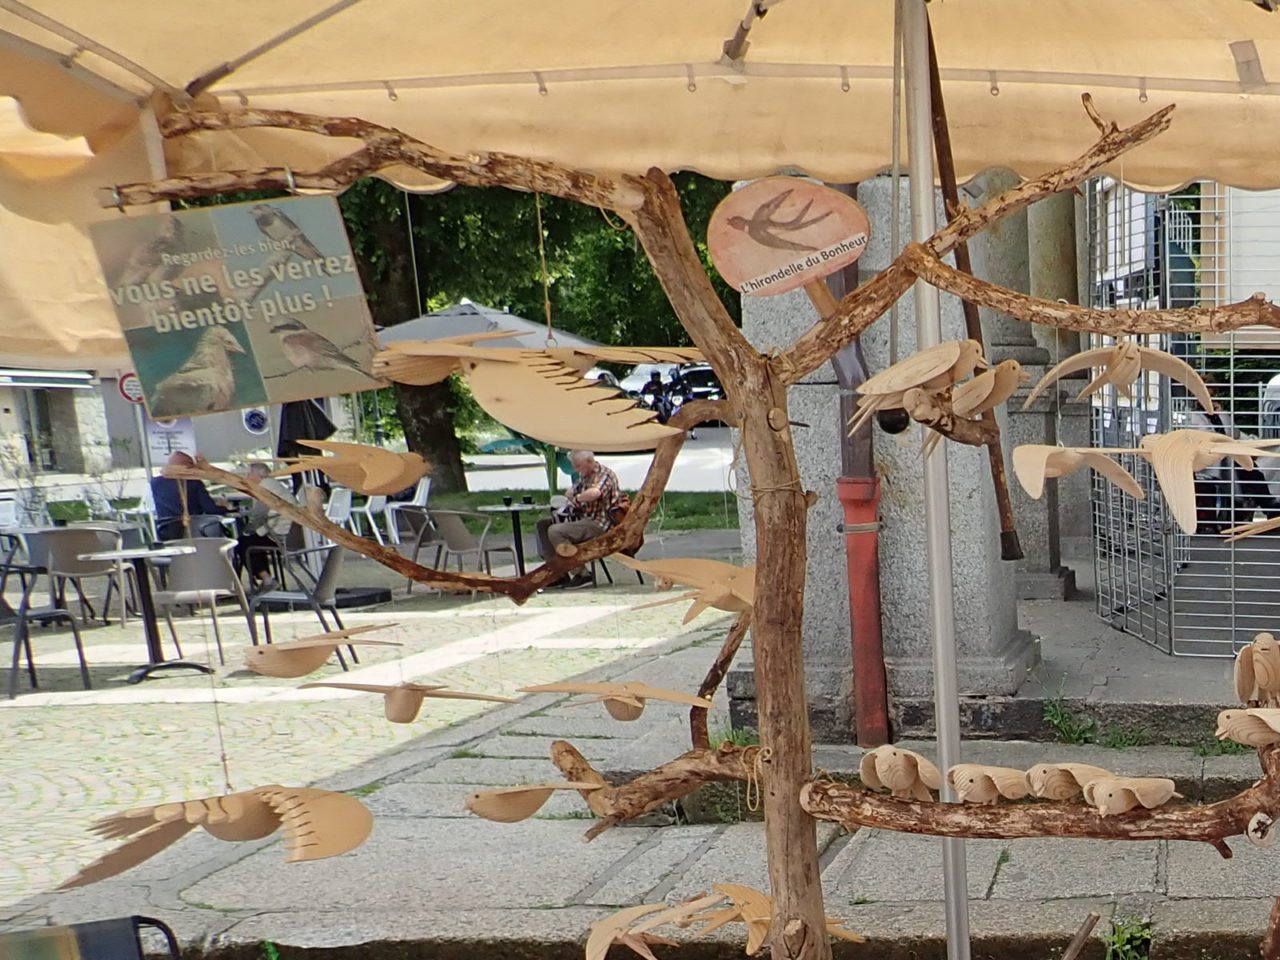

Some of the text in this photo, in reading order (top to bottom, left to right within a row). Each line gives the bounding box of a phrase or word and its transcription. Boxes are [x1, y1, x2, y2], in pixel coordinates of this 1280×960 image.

[161, 238, 296, 267] Regardez-les bien,
[740, 234, 868, 294] L'hirondelle du Bonheur
[111, 254, 355, 305] vous ne les verrez
[153, 297, 253, 333] bientôt
[260, 289, 318, 322] plus
